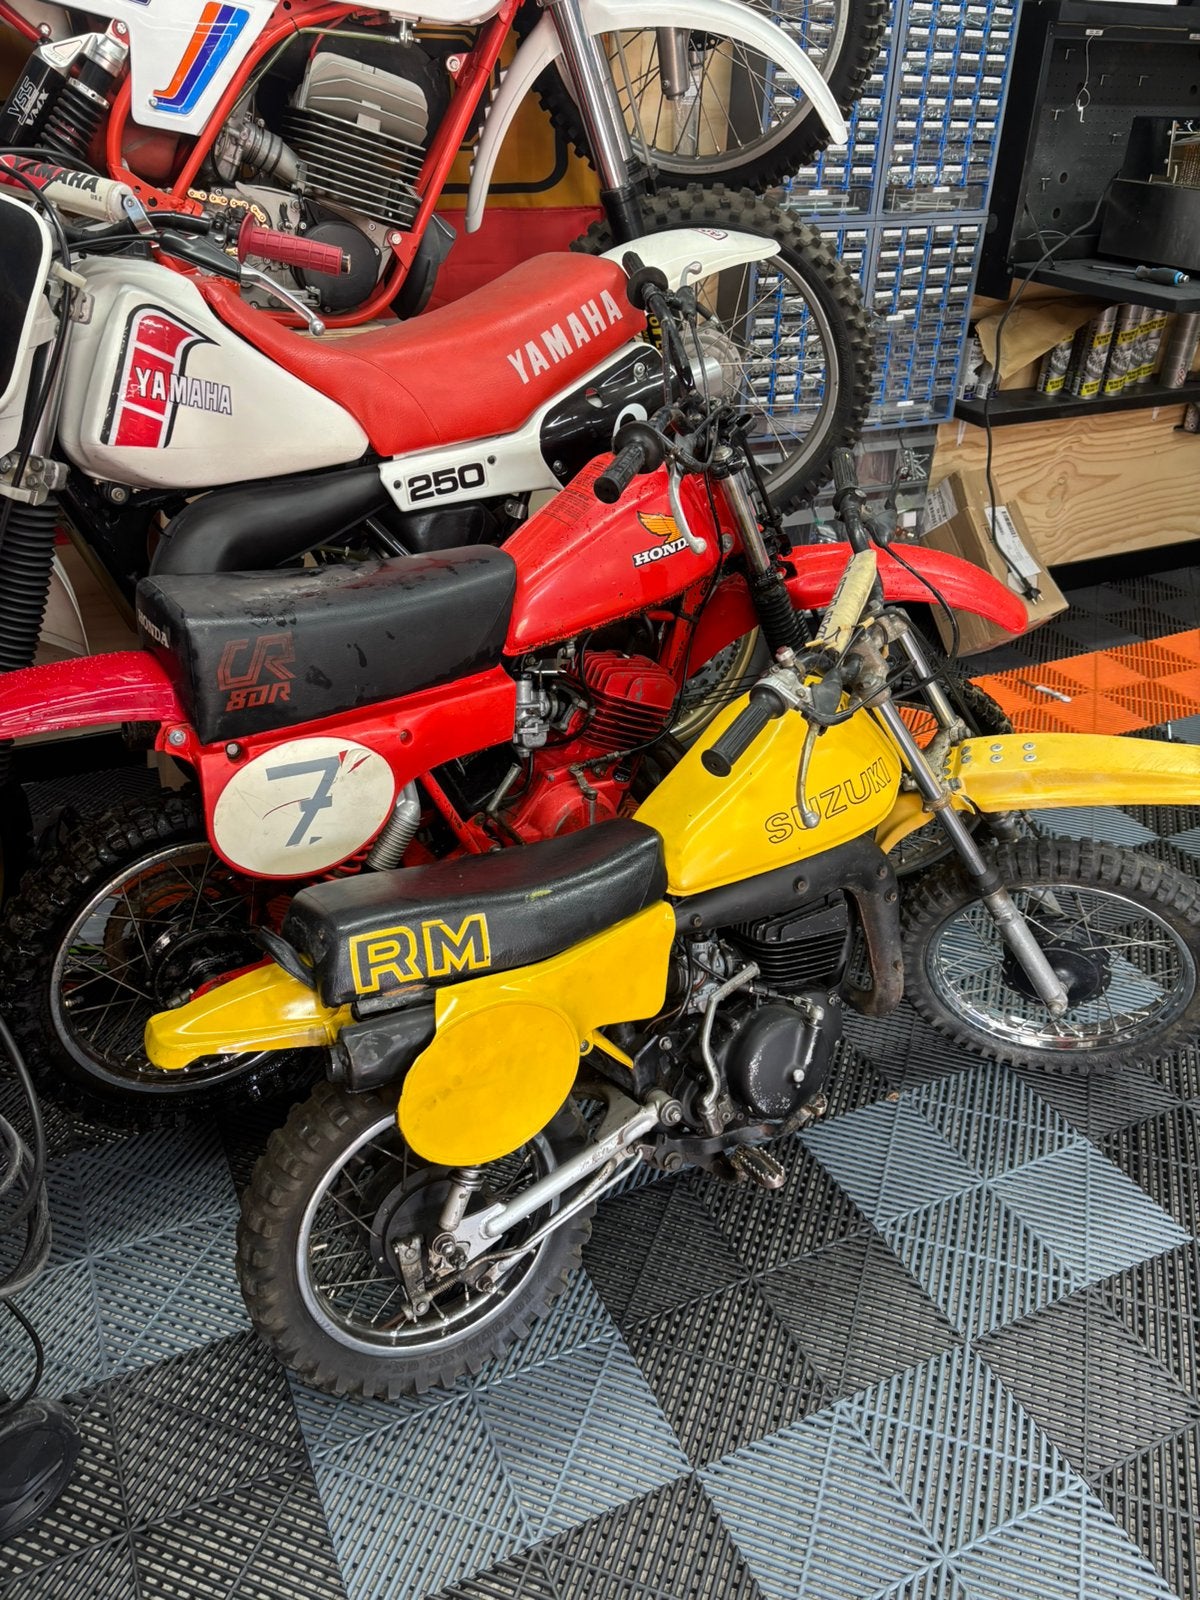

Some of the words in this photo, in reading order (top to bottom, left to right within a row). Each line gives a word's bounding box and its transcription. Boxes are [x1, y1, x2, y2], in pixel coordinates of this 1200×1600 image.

[25, 88, 50, 126] VMX
[13, 156, 100, 193] YAMAHA
[507, 289, 623, 384] YAMAHA
[134, 366, 233, 416] YAMAHA
[408, 462, 485, 502] 250
[632, 536, 690, 568] HOND
[137, 608, 170, 649] HONDA
[217, 630, 297, 691] CR
[225, 681, 291, 712] 80R
[265, 754, 341, 847] 7
[764, 757, 892, 844] SUZUKI
[349, 912, 491, 995] RM
